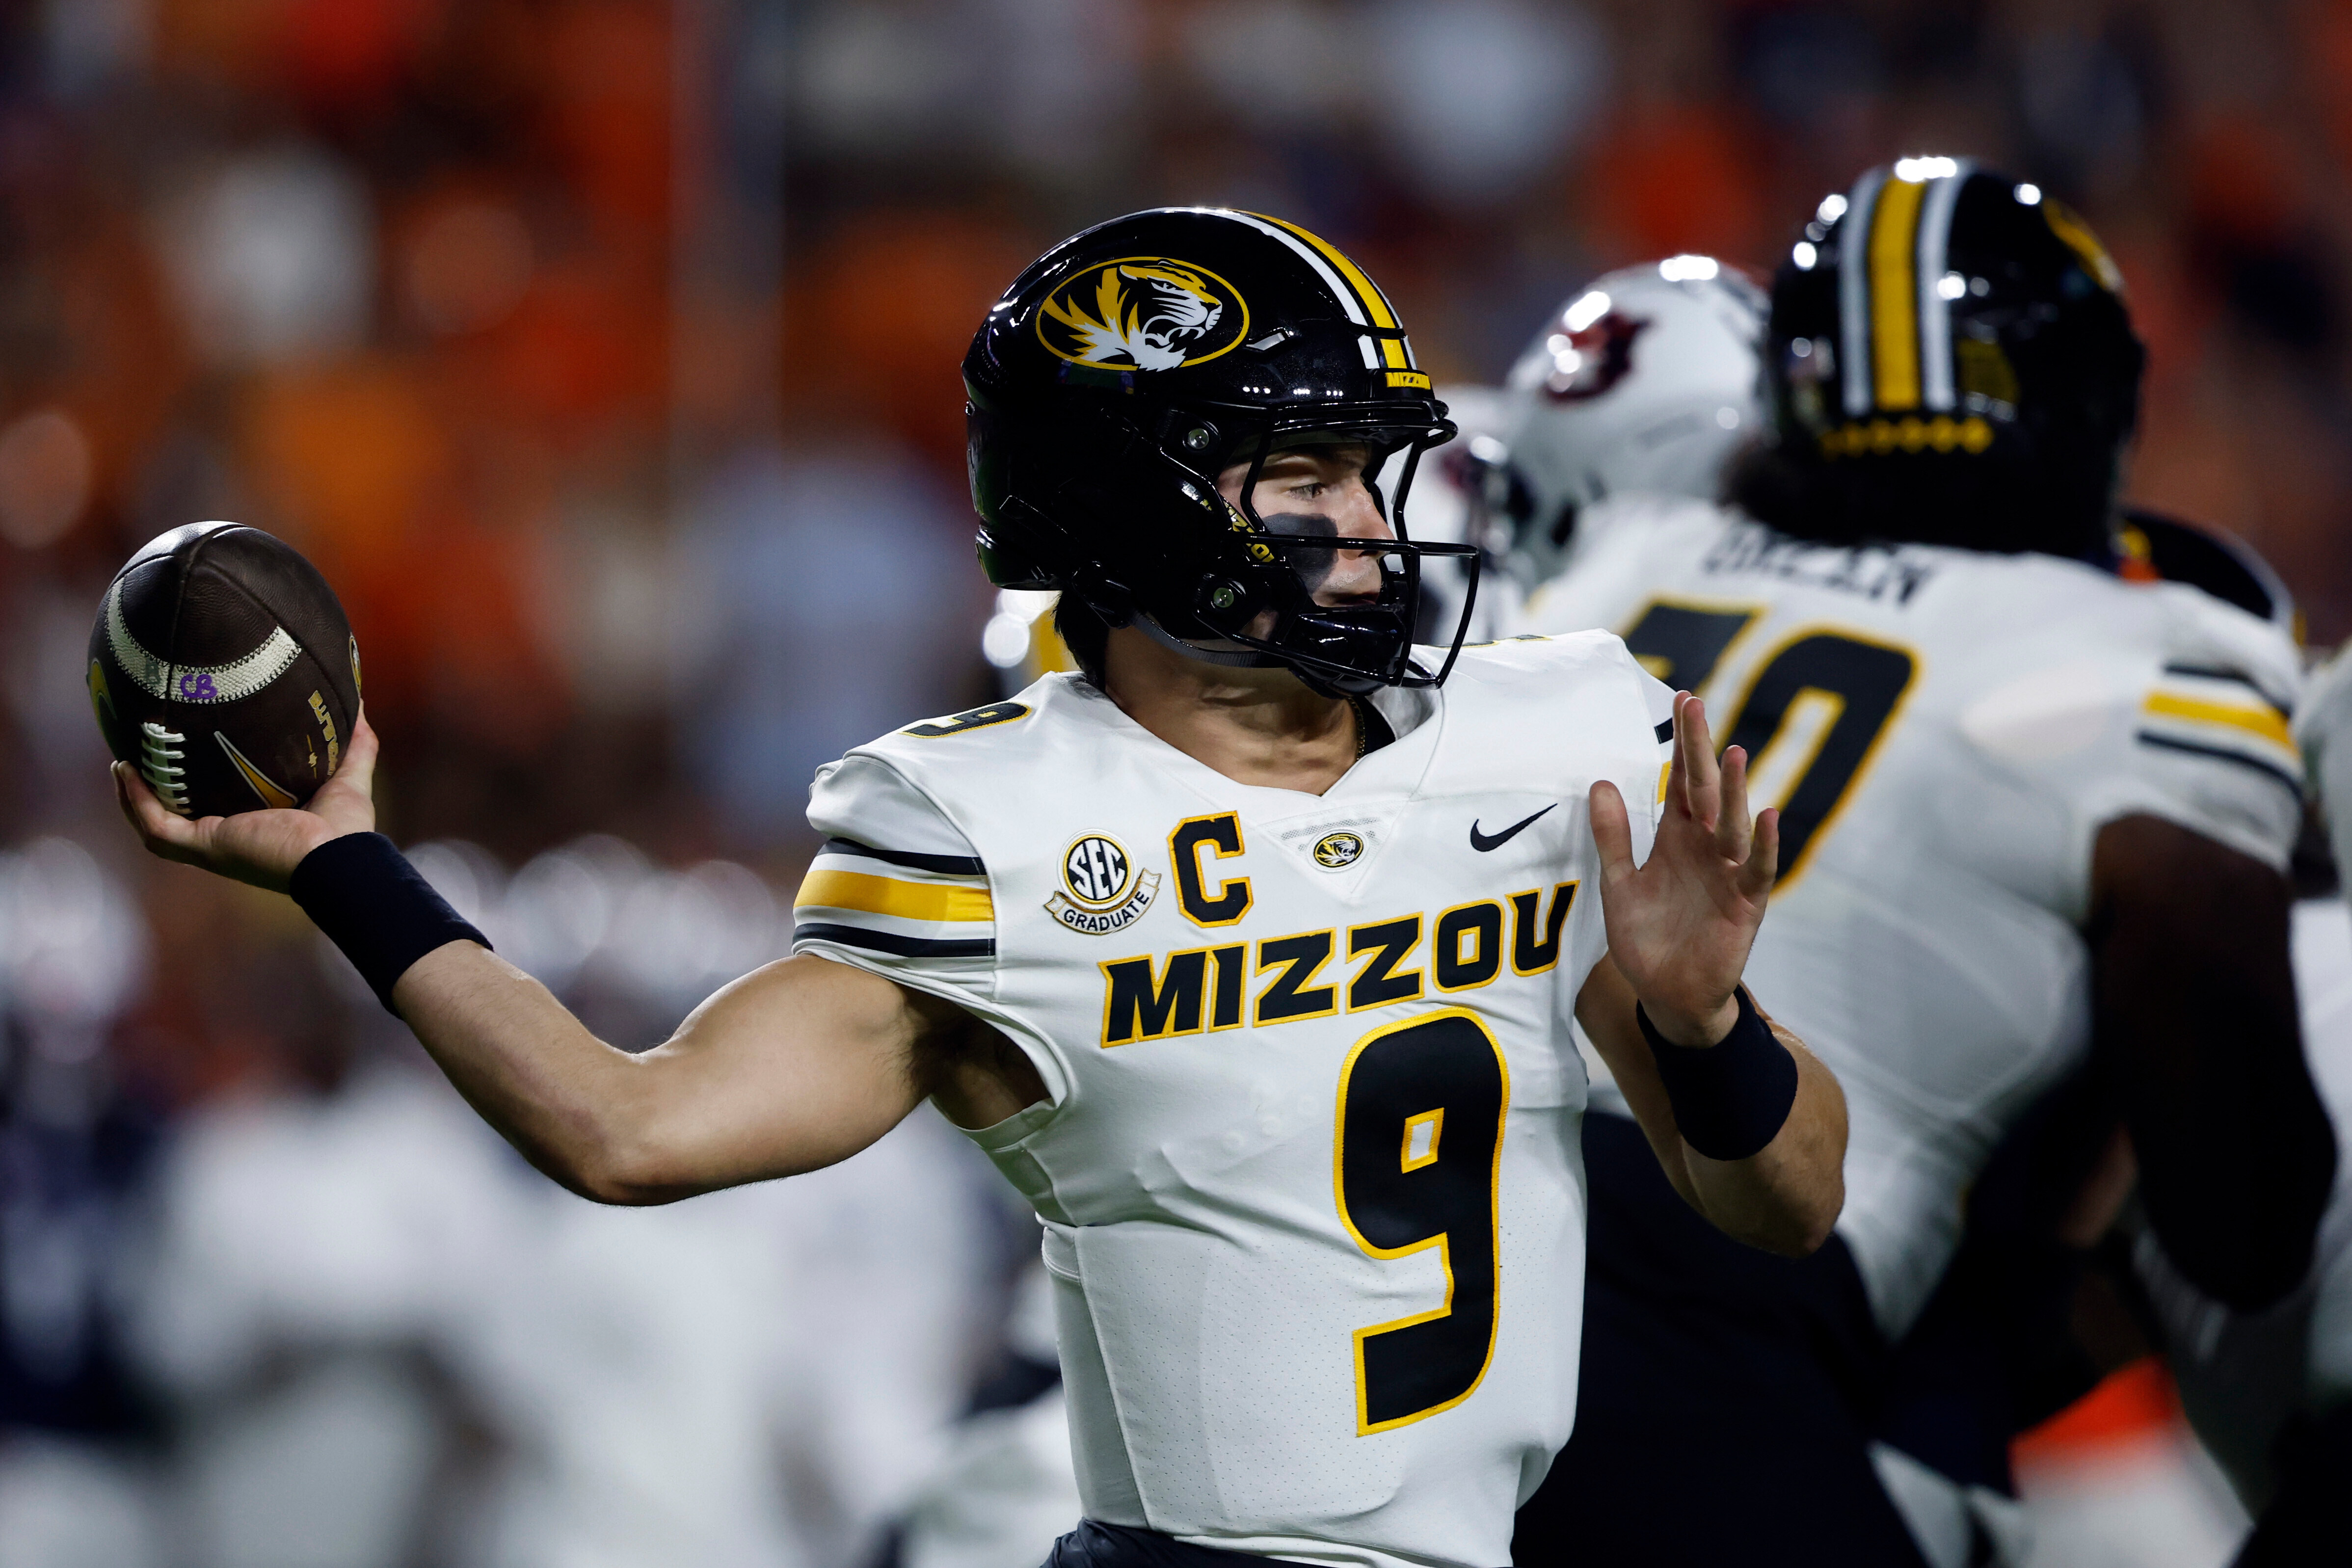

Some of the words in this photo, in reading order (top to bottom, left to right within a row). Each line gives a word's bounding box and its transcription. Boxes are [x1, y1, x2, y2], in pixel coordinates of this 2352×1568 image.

[180, 674, 217, 699] CB
[898, 702, 1032, 738] 9
[1069, 838, 1126, 901] SEC
[1167, 810, 1255, 928] C
[1064, 891, 1149, 931] GRADUATE
[1098, 880, 1580, 1048] MIZZOU
[1333, 1007, 1510, 1437] 9
